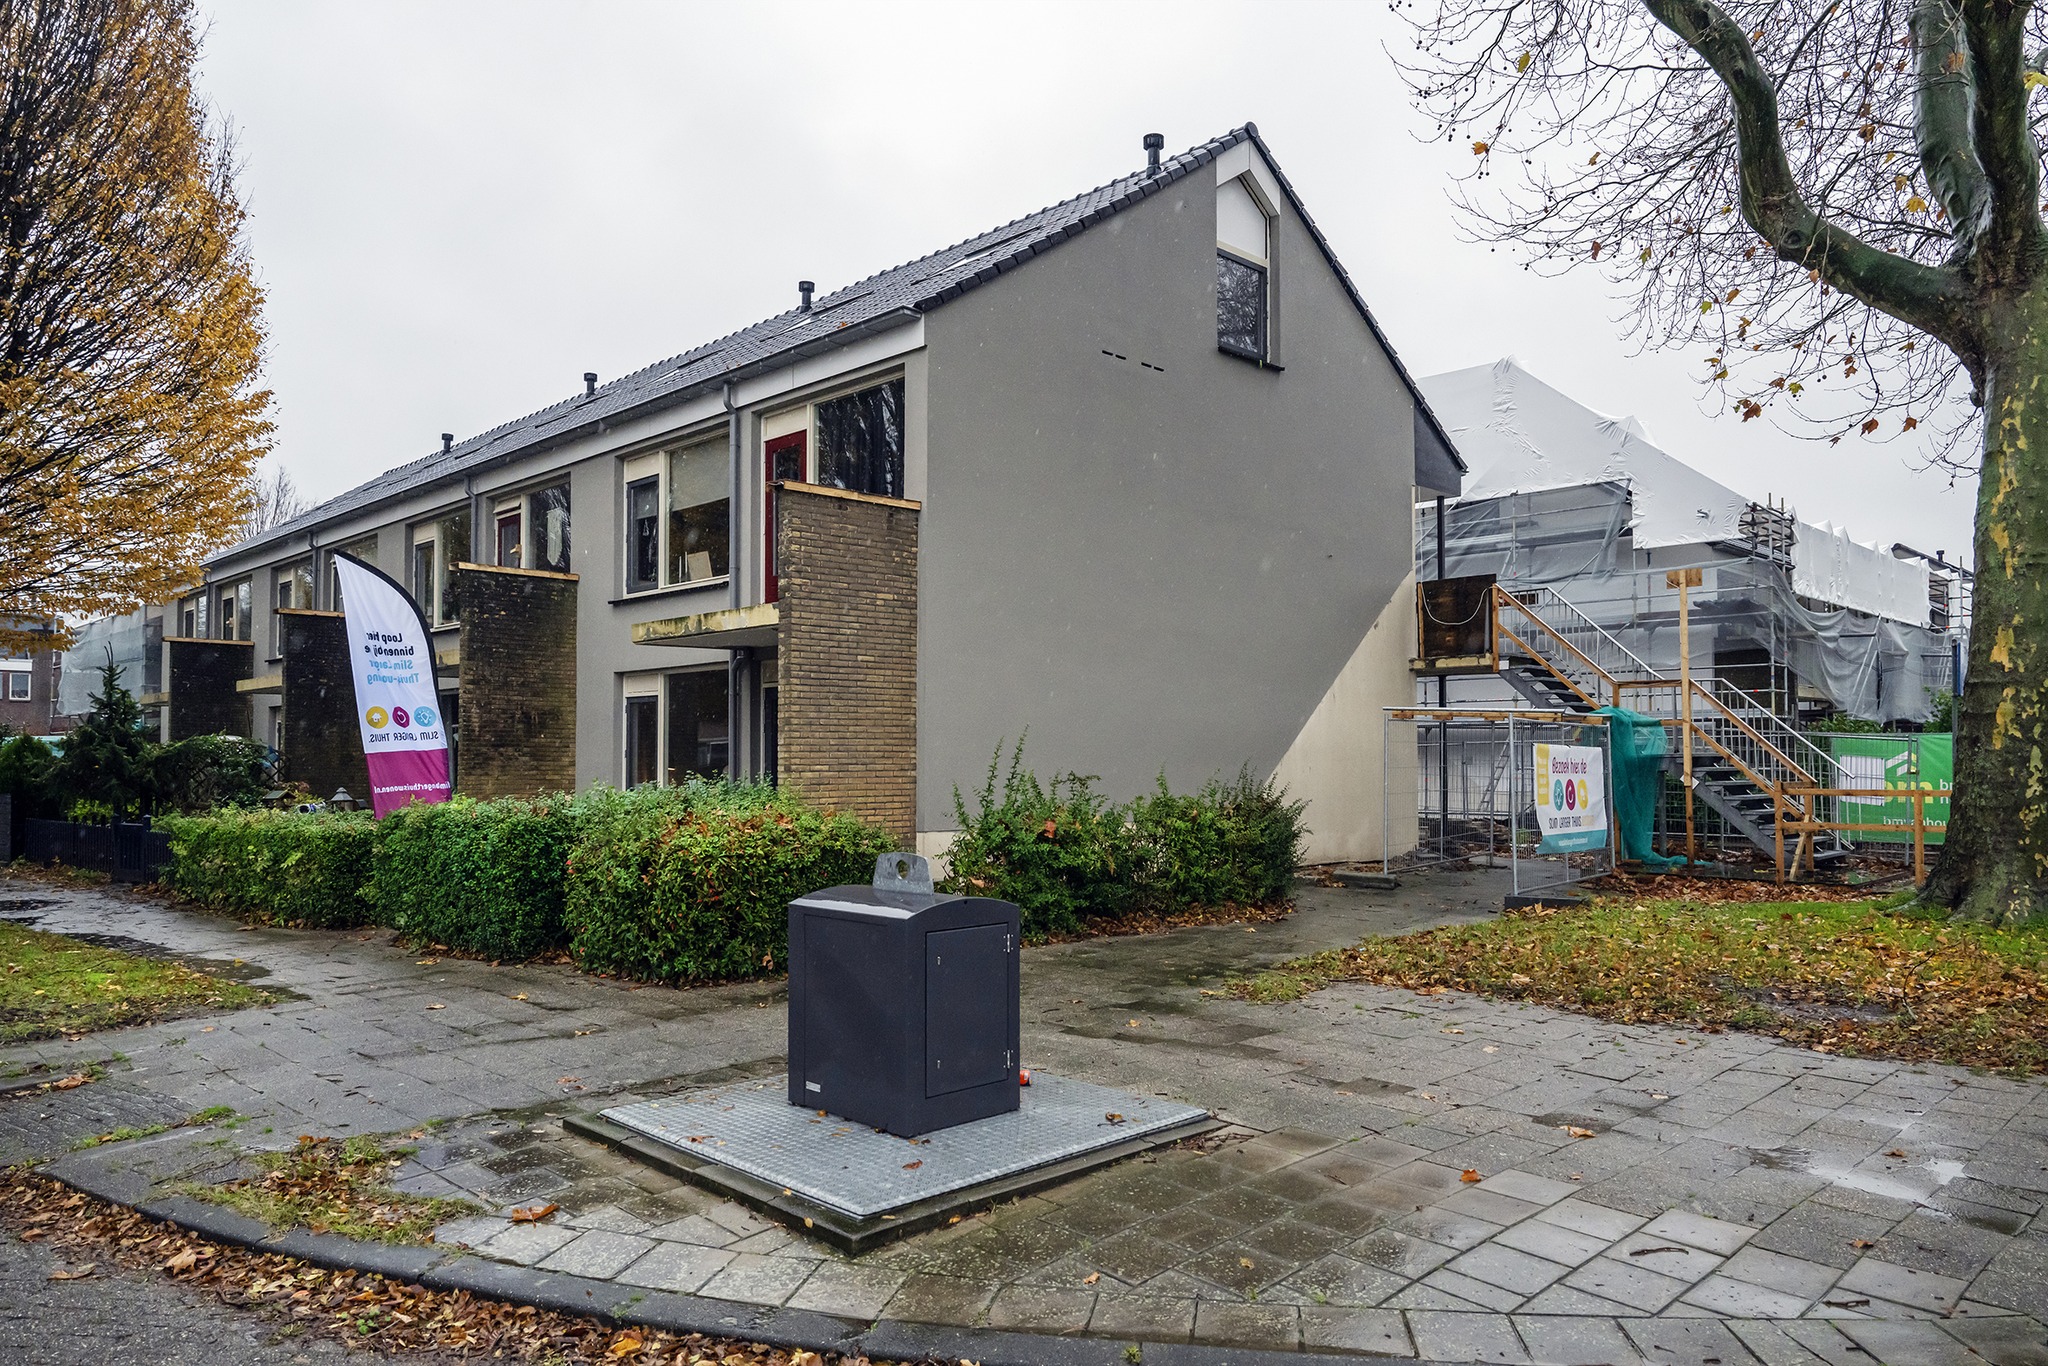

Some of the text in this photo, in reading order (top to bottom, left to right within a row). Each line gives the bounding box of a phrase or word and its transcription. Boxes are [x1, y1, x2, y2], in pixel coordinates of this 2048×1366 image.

[1552, 757, 1587, 774] Bezoek hier de
